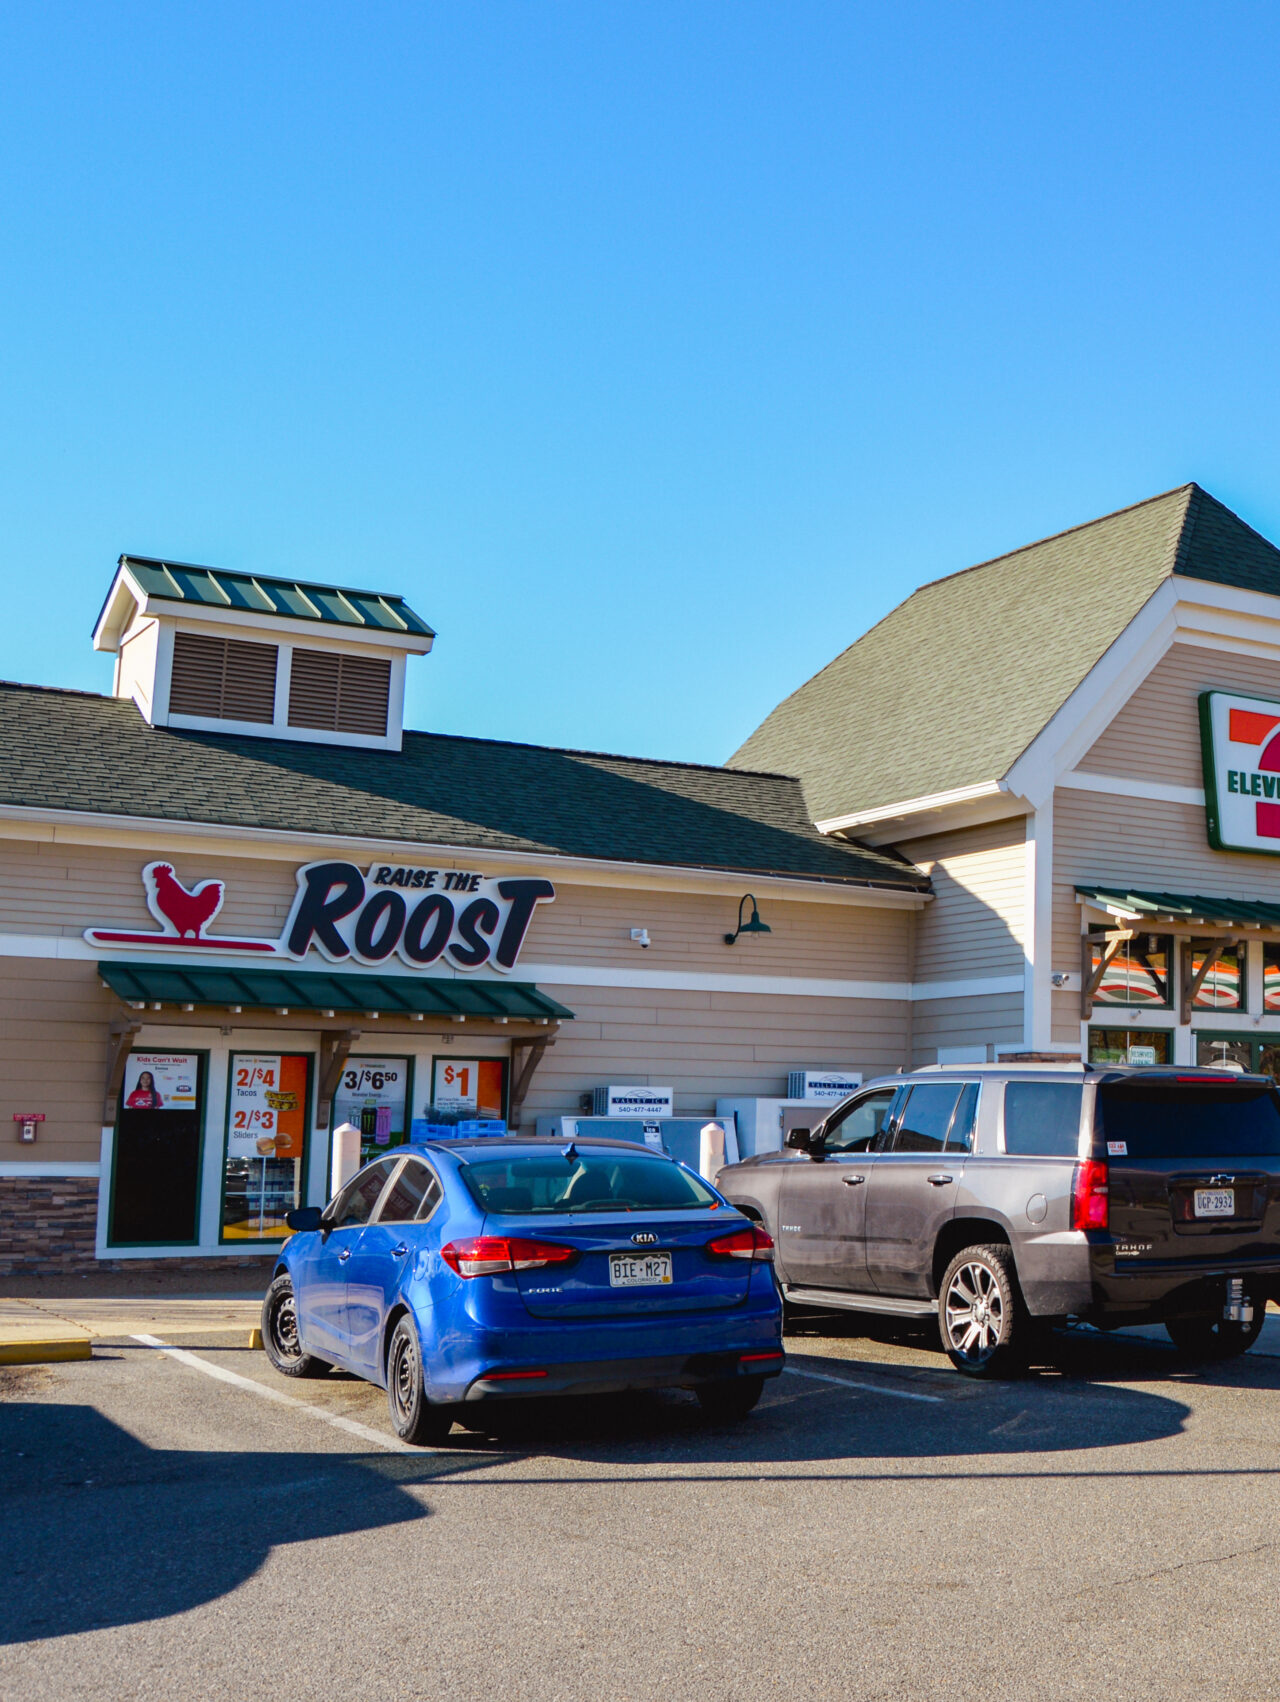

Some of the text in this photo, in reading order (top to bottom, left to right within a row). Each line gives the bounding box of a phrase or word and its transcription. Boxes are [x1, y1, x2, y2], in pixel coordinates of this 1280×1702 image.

[373, 866, 483, 892] RAISE THE
[288, 862, 555, 969] ROOST
[236, 1068, 275, 1088] 2/$4
[444, 1065, 470, 1097] $1
[236, 1089, 257, 1097] Tacos
[234, 1110, 274, 1130] 2/$3
[233, 1131, 258, 1139] Sliders
[636, 1233, 656, 1243] KIA
